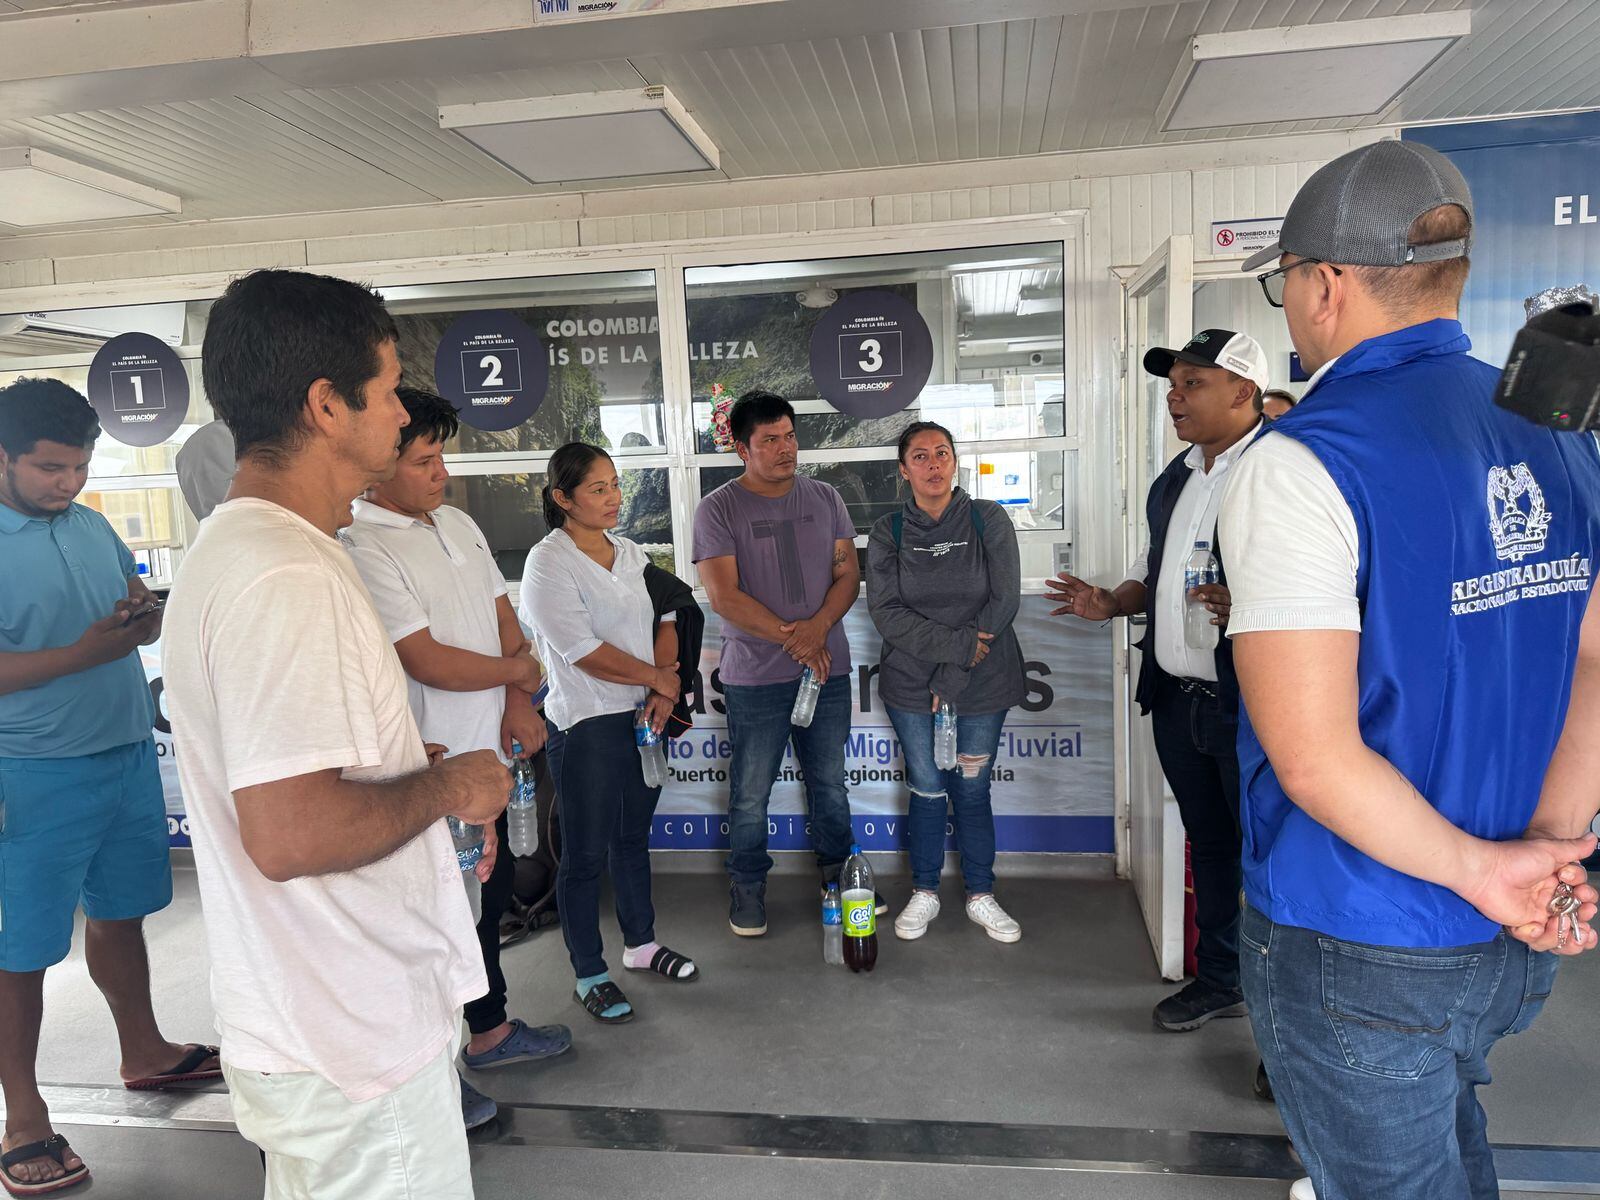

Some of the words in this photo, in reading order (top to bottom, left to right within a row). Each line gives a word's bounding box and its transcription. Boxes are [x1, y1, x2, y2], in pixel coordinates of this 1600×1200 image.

[1554, 195, 1597, 225] EL
[546, 316, 659, 338] COLOMBIA
[549, 344, 570, 366] ÍS
[581, 347, 609, 366] DE
[620, 345, 648, 364] LA
[689, 340, 759, 361] LLEZA
[858, 338, 883, 373] 3
[479, 354, 504, 387] 2
[130, 375, 144, 404] 1
[848, 382, 890, 391] MIGRACIÓN
[471, 396, 511, 405] MIGRACIÓN
[121, 413, 157, 422] MIGRACIÓN
[702, 734, 732, 759] de
[667, 766, 727, 782] Puerto
[844, 766, 907, 785] egional
